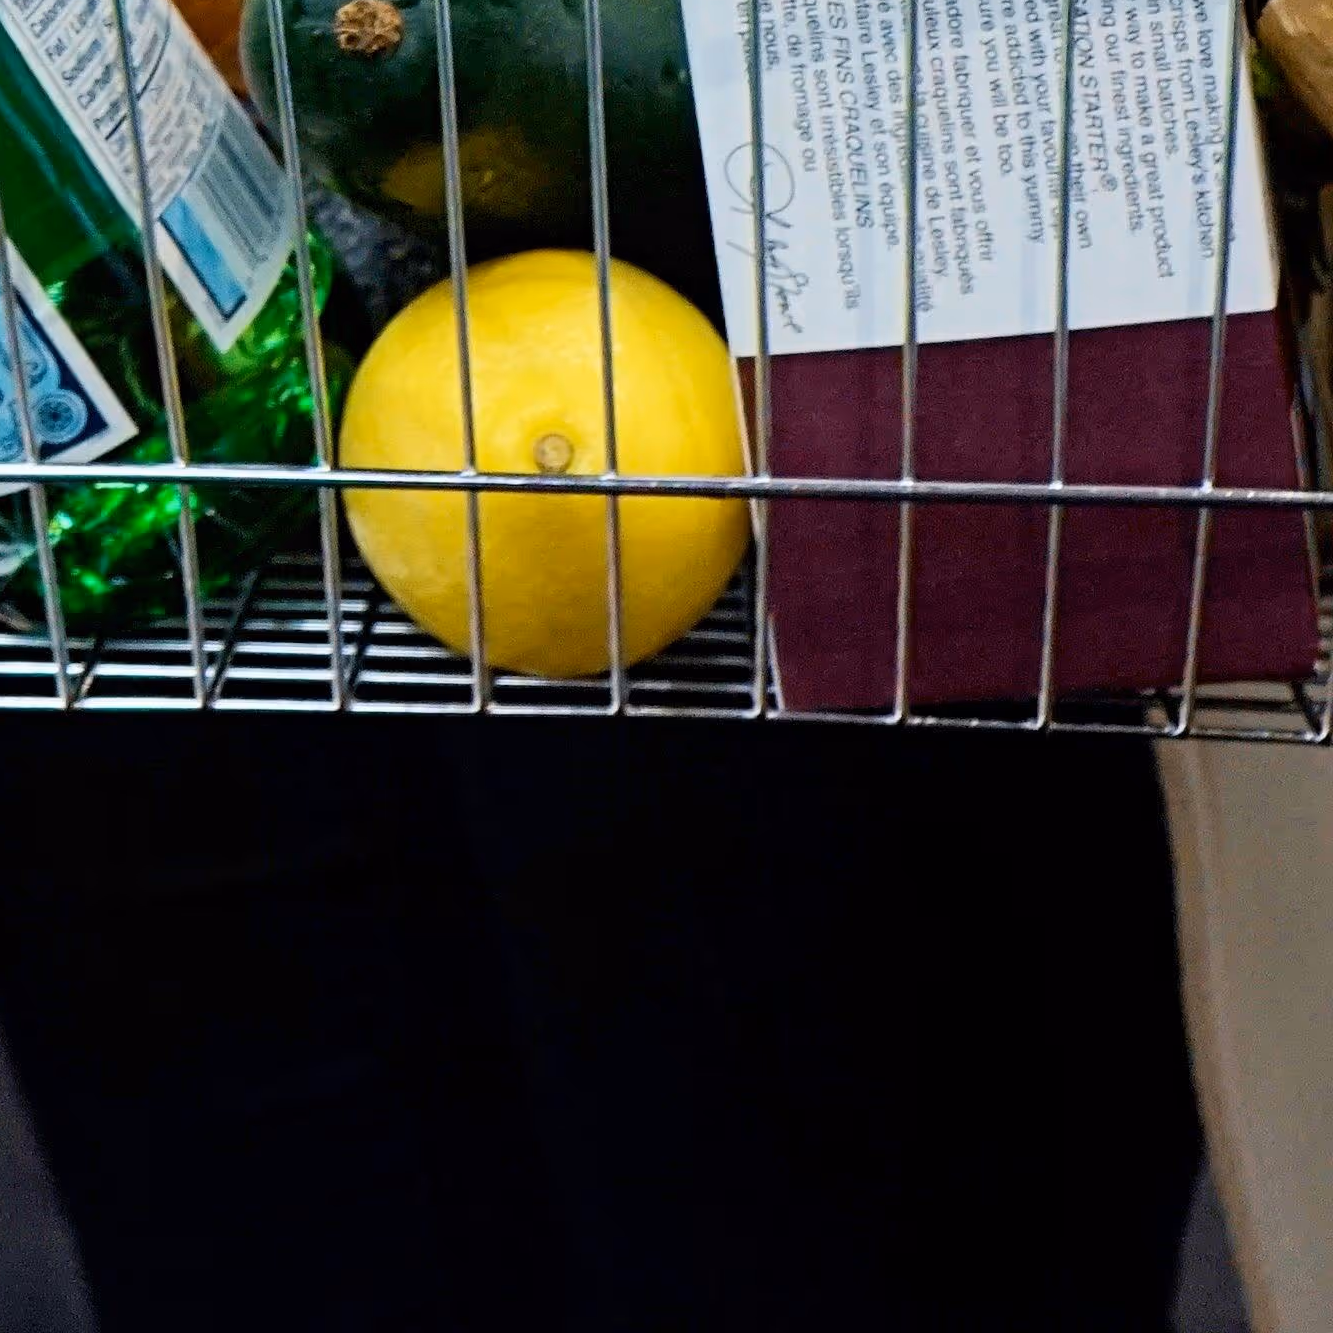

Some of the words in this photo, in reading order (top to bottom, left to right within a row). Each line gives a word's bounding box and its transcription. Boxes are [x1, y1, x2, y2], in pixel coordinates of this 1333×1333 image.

[785, 32, 805, 58] de
[879, 18, 899, 64] avec
[1027, 27, 1050, 68] with
[1103, 32, 1121, 63] our
[1122, 6, 1142, 46] way
[1148, 19, 1173, 73] small
[830, 34, 855, 85] FINS
[978, 37, 1001, 73] you
[1003, 23, 1032, 107] addicted
[1129, 50, 1147, 70] to
[1196, 28, 1214, 69] love
[813, 67, 835, 110] sont
[860, 49, 883, 112] Lesley
[886, 68, 905, 104] des
[952, 53, 977, 140] fabriquer
[988, 77, 1009, 108] will
[1029, 71, 1052, 112] your
[1108, 68, 1131, 122] finest
[1132, 74, 1155, 128] make
[1176, 57, 1195, 102] from
[789, 62, 814, 143] fromage
[1015, 111, 1033, 130] to
[1156, 76, 1180, 160] batches.
[1202, 74, 1225, 146] making
[869, 117, 888, 136] et
[928, 55, 957, 155] craquelins
[943, 159, 965, 202] sont
[993, 113, 1012, 138] be
[1140, 132, 1155, 146] a
[1182, 106, 1208, 186] Lesley's
[801, 147, 818, 173] ou
[819, 114, 848, 221] irrésistibles
[838, 89, 874, 229] CRAQUELINS
[872, 139, 890, 176] son
[964, 144, 983, 164] et
[1018, 134, 1039, 169] this
[924, 184, 943, 211] de
[967, 168, 987, 215] vous
[1138, 150, 1165, 201] great
[1019, 173, 1046, 245] yummy
[1074, 208, 1093, 250] own
[1193, 189, 1216, 260] kitchen
[928, 215, 951, 279] Lesley
[974, 218, 996, 262] offrir
[1145, 205, 1175, 279] product
